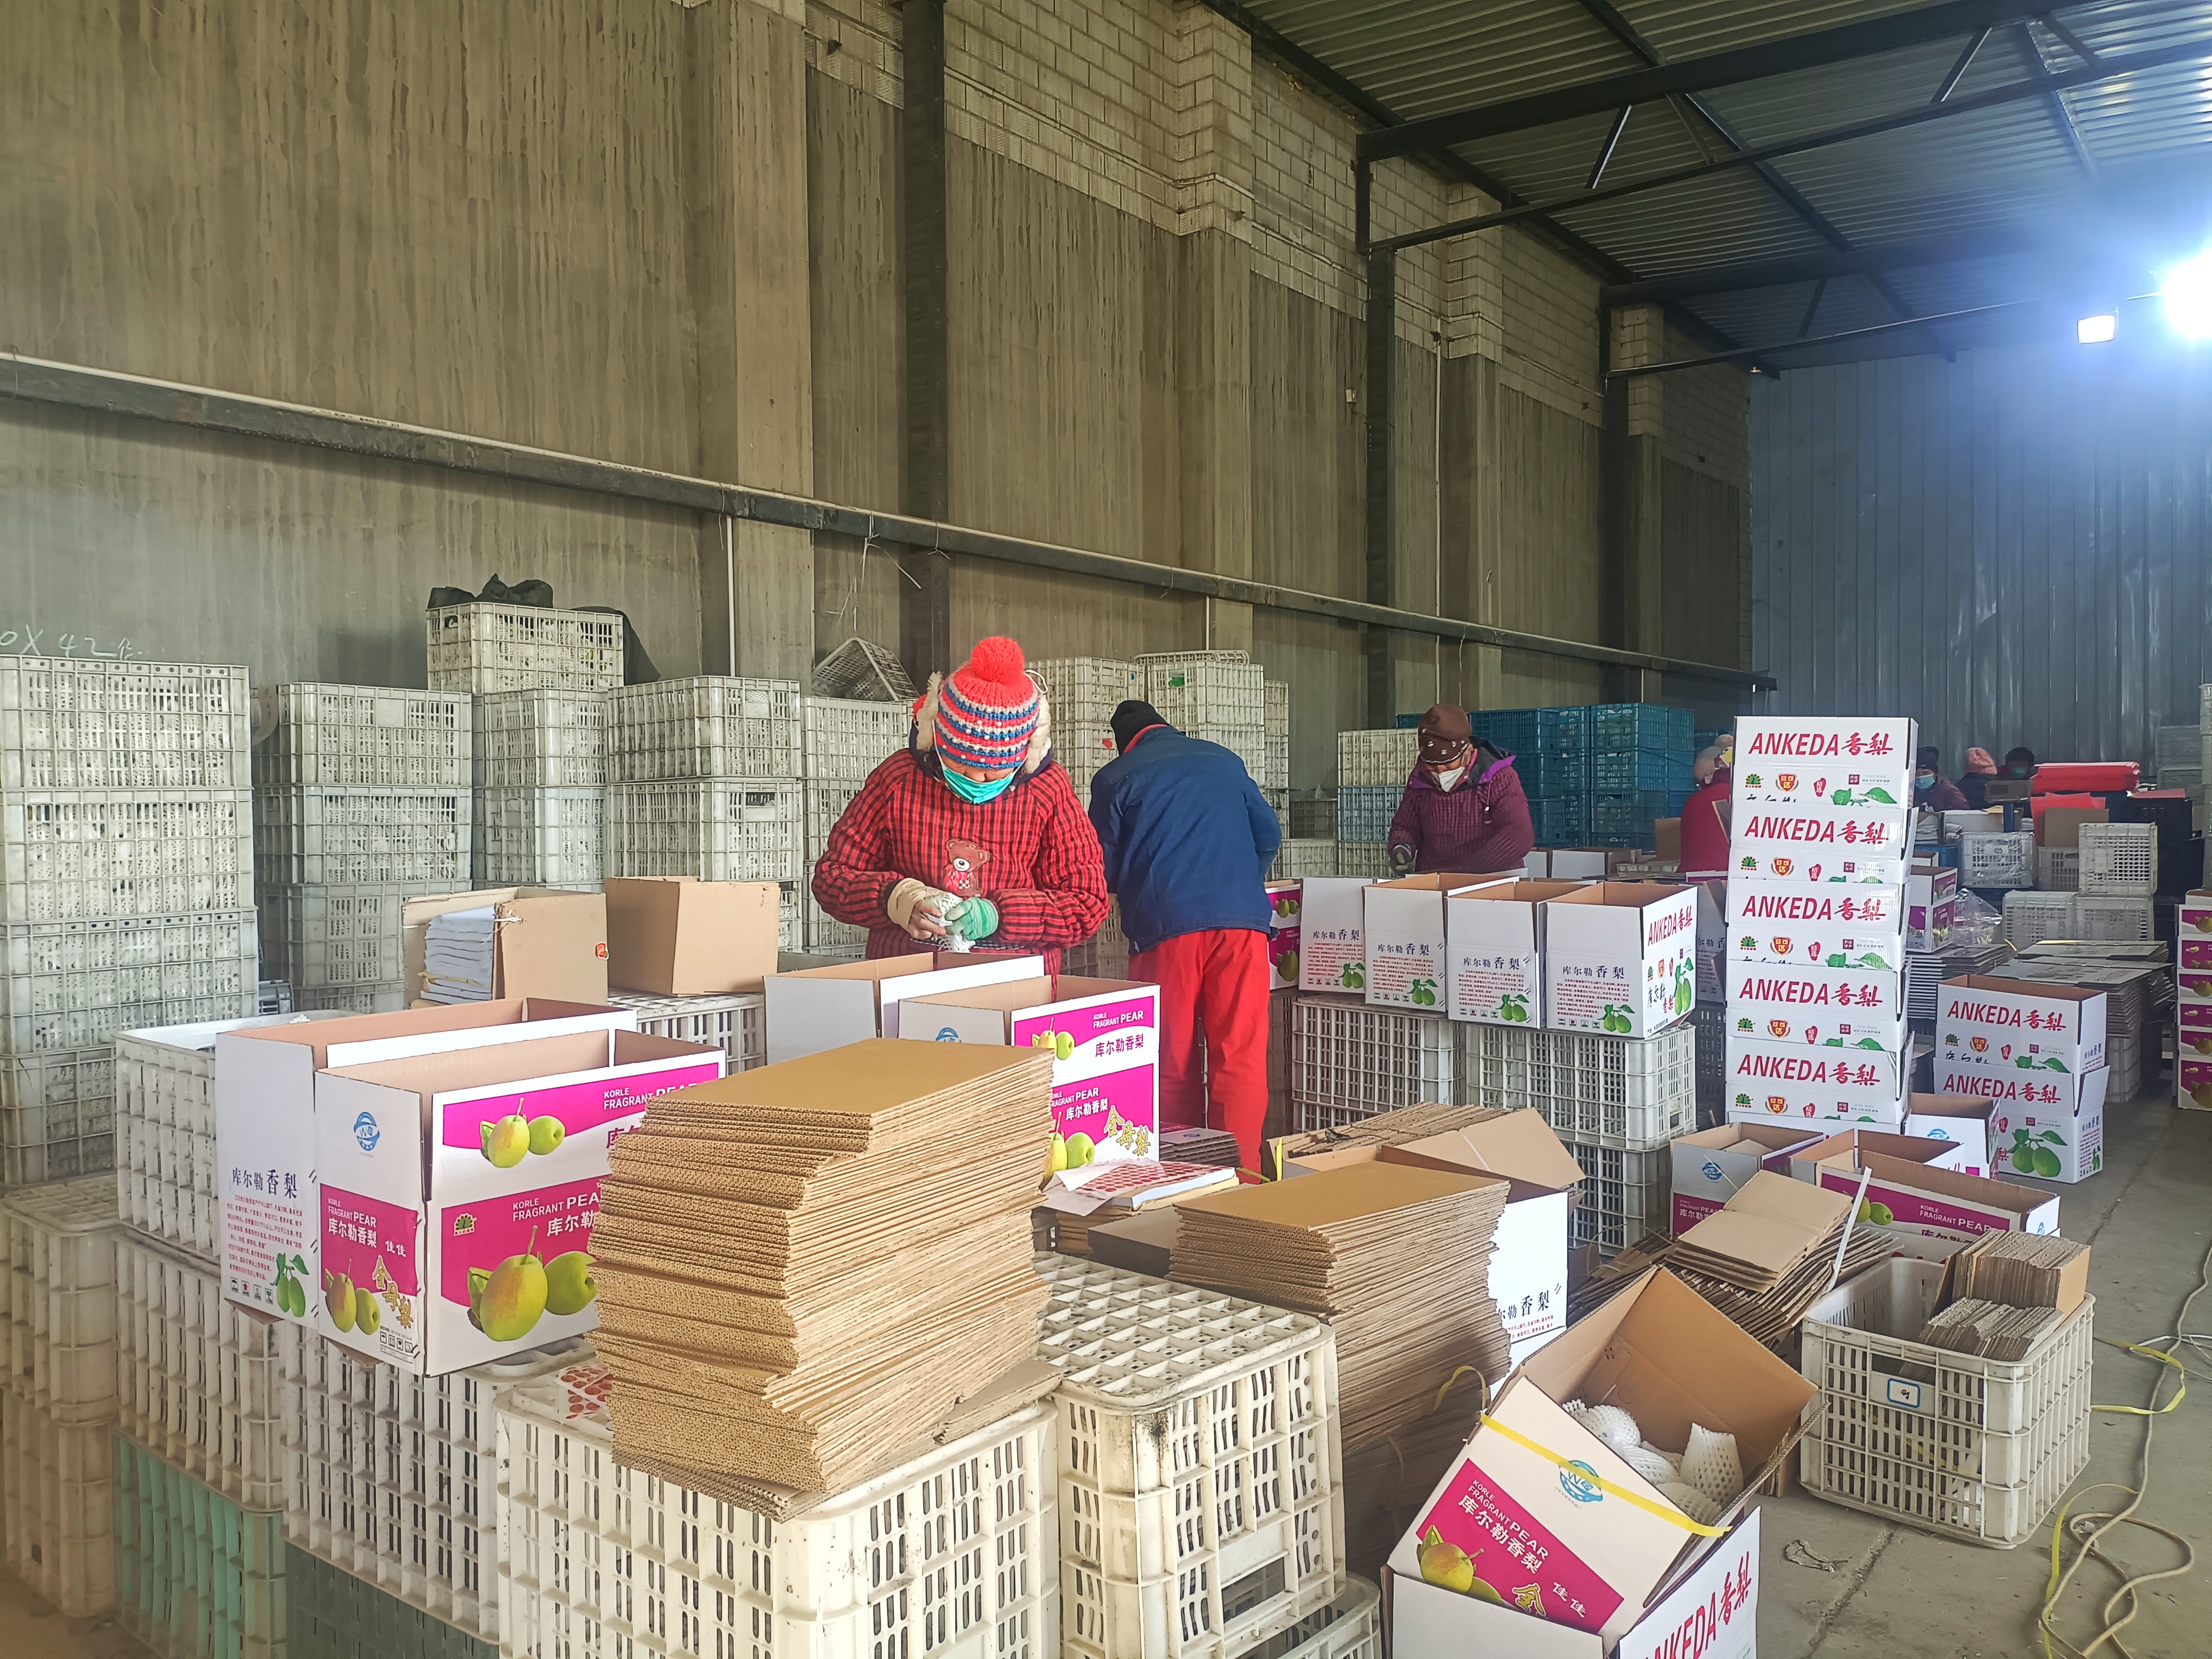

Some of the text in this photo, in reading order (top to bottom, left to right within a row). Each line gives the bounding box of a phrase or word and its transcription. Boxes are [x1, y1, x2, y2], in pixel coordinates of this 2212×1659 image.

[1748, 733, 1893, 756] ANKEDA 香梨
[1744, 816, 1888, 844] ANKEDA 香梨
[1742, 896, 1886, 921] ANKEDA 香梨
[1312, 929, 1360, 941] 库尔勒香梨
[1647, 905, 1693, 946] ANKEDA 香梨
[1378, 943, 1430, 956] 库尔勒香梨
[1463, 957, 1520, 971] 库尔勒香梨
[1563, 965, 1625, 979] 库尔勒香梨
[1739, 978, 1883, 1007] ANKEDA 香梨
[1093, 1010, 1144, 1029] FRAGRANT PEAR
[1947, 1000, 2066, 1031] ANKEDA 香梨
[1095, 1034, 1144, 1057] 库尔勒香梨
[1737, 1054, 1880, 1086] ANKEDA 香梨
[604, 1087, 630, 1099] KORLE
[1051, 1087, 1099, 1108] RAGRANT PEAR
[1943, 1074, 2061, 1104] ANKEDA 香梨
[1065, 1097, 1108, 1121] 库尔勒香梨
[232, 1167, 297, 1199] 库尔勒香梨
[328, 1206, 376, 1228] FRAGRANT PEAR
[512, 1192, 599, 1221] FRAGRANT PEA
[513, 1198, 540, 1211] KORLE
[1920, 1204, 1939, 1214] KORLE
[1920, 1210, 1956, 1224] FRAGRANT
[328, 1218, 377, 1248] 库尔勒香梨
[547, 1210, 595, 1237] 库尔勒
[1498, 1290, 1549, 1320] 尔勒香梨
[1473, 1479, 1495, 1501] KORLE
[1458, 1494, 1542, 1574] 库尔勒香梨
[1468, 1486, 1511, 1525] FRAGRANT
[1510, 1521, 1549, 1560] PEAR
[1552, 1582, 1586, 1618] 佳佳
[1718, 1551, 1752, 1625] 香梨
